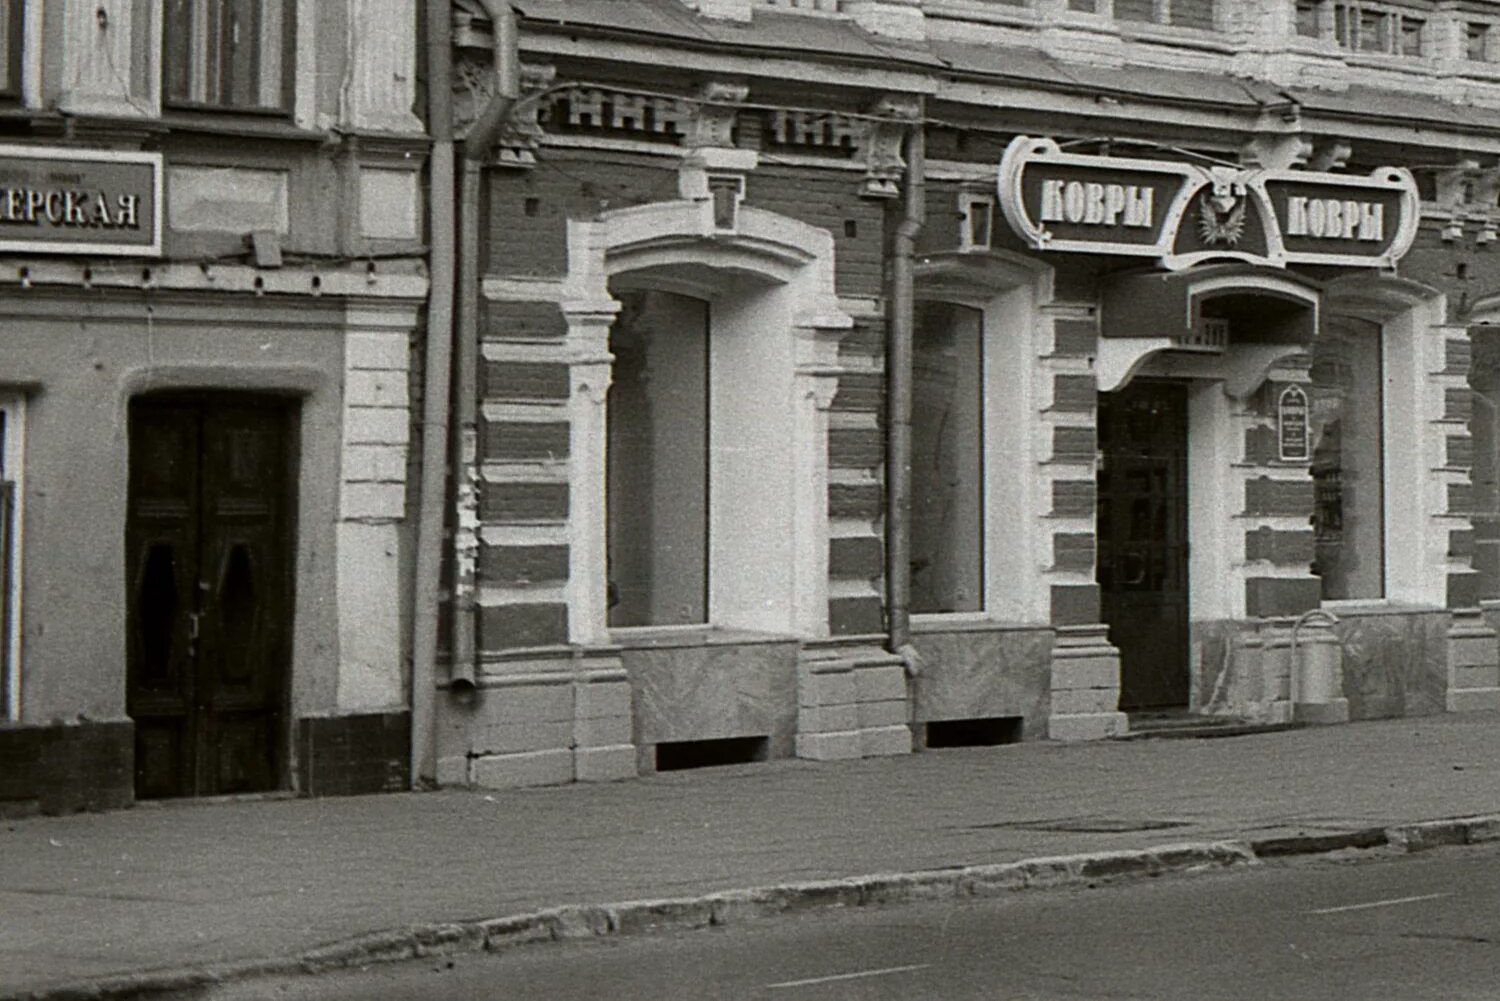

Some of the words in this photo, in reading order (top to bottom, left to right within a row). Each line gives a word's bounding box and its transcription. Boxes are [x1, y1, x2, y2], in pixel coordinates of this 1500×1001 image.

[0, 187, 139, 228] ЕРСКАЯ
[1040, 179, 1154, 228] КОВРЫ
[1287, 196, 1384, 242] КОВРЫ
